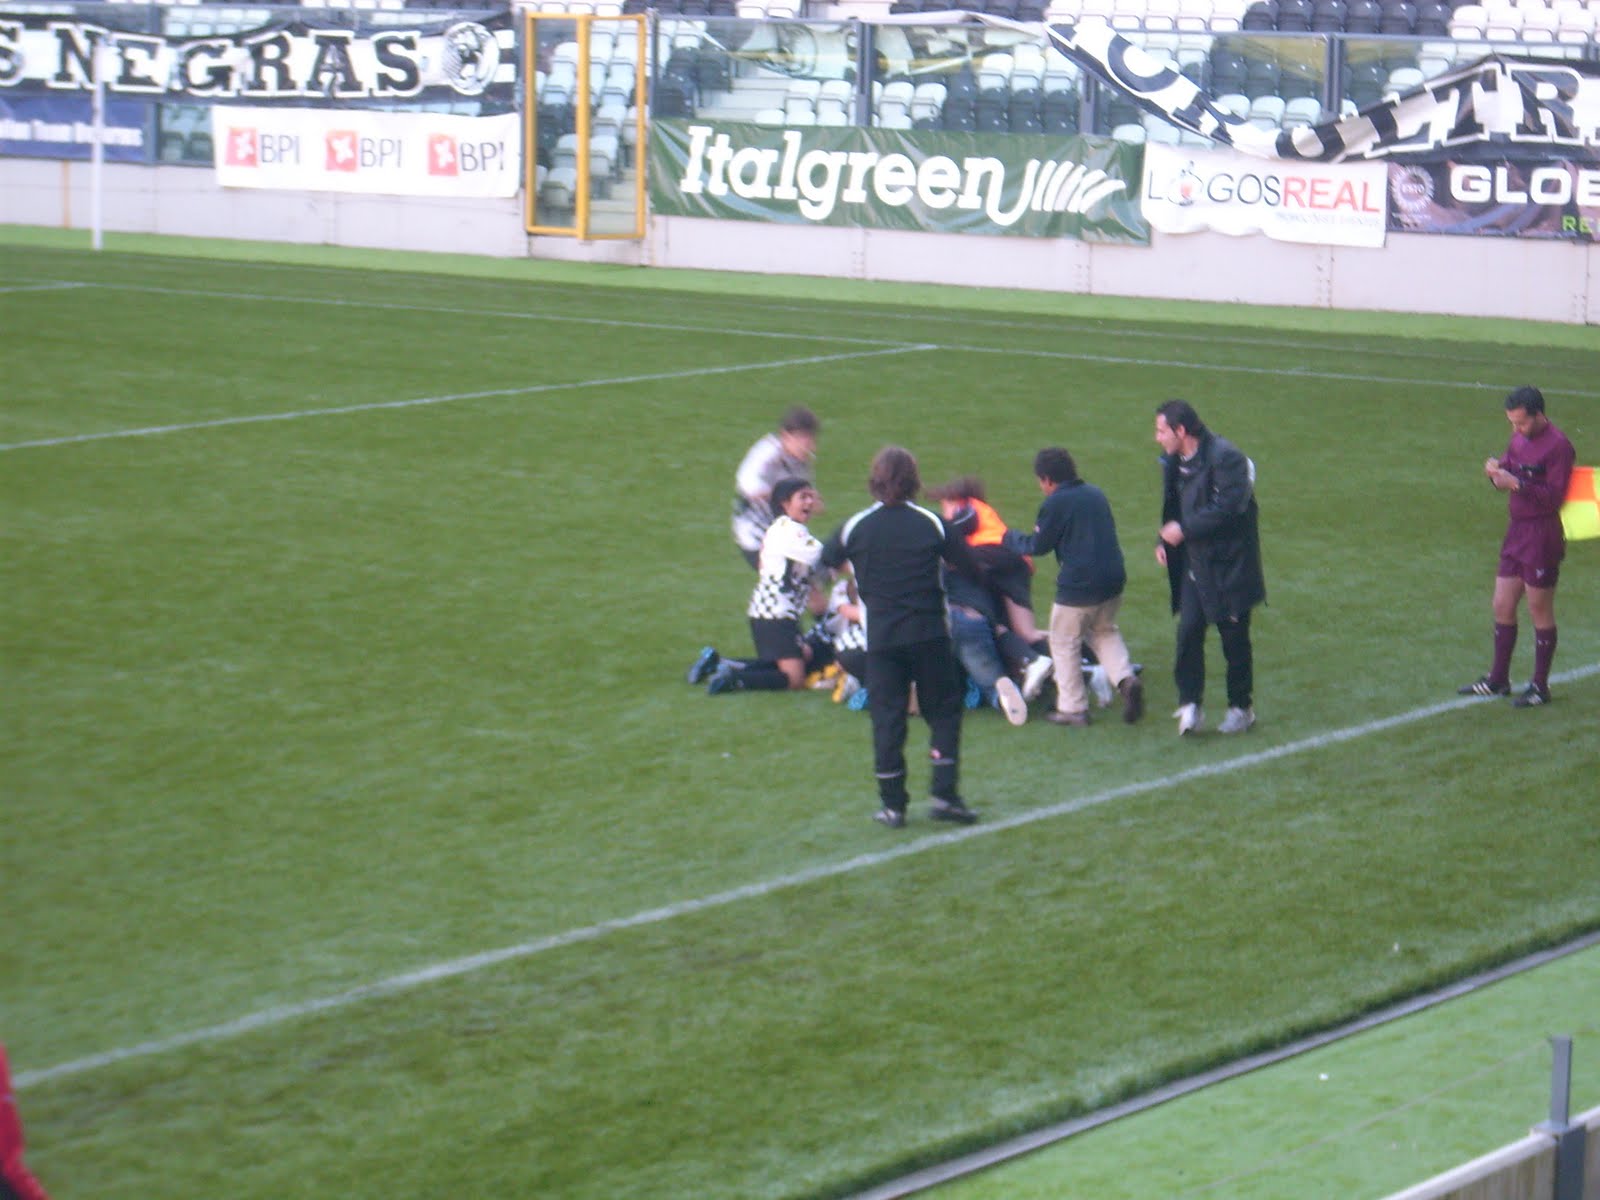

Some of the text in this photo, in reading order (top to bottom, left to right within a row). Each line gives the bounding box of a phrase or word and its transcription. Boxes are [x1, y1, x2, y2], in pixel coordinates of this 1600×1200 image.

[48, 22, 425, 97] NEGRAS
[260, 134, 300, 164] BPI
[360, 137, 402, 168] BPI
[460, 142, 504, 171] BPI
[680, 125, 1024, 226] Italgreen
